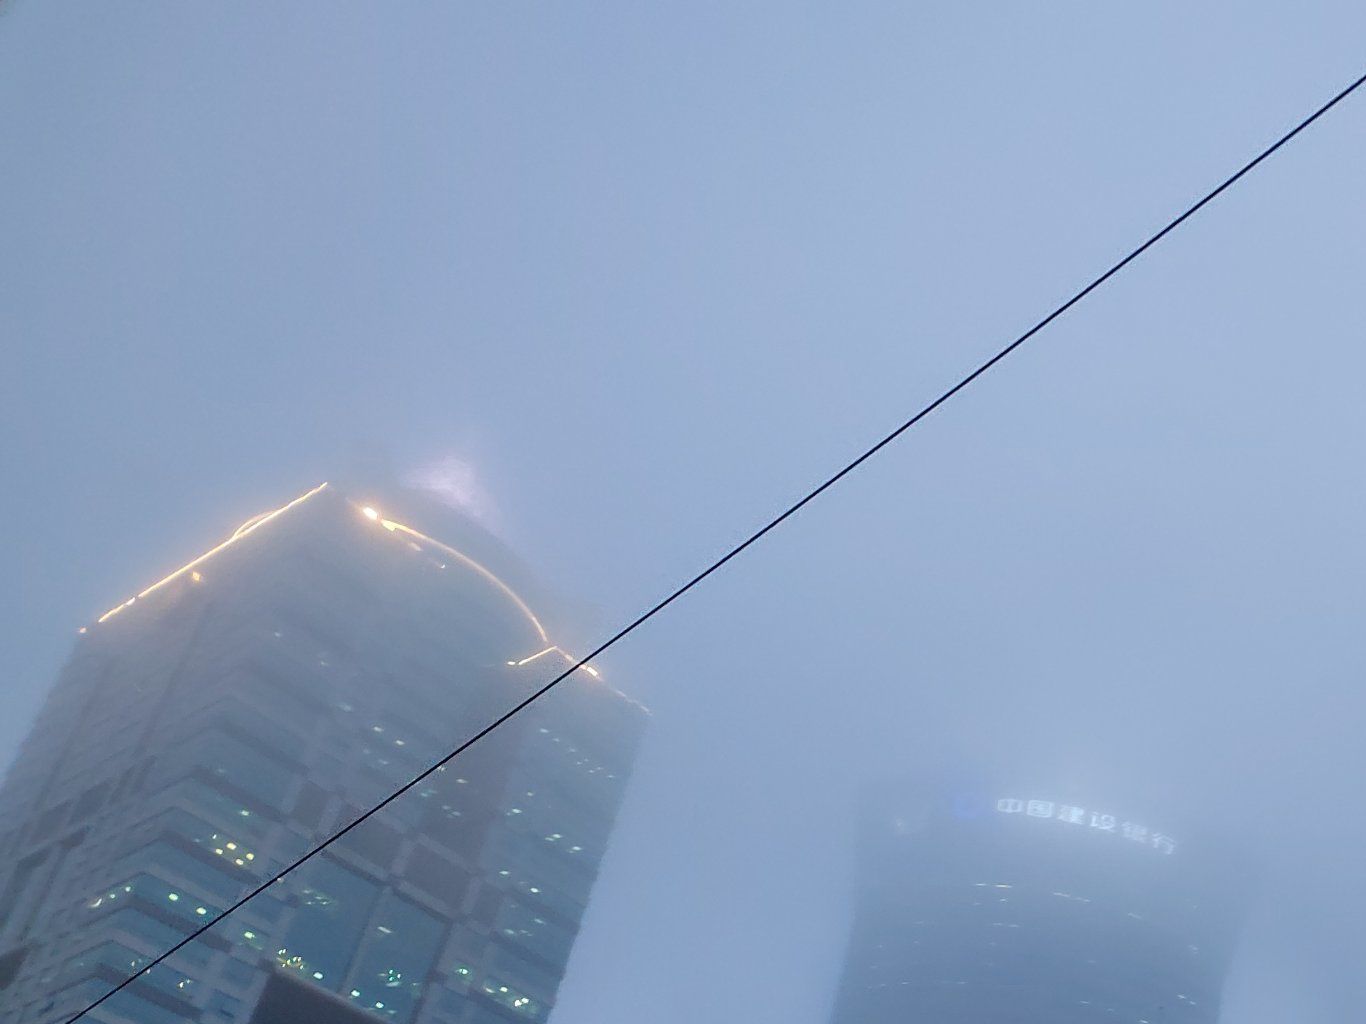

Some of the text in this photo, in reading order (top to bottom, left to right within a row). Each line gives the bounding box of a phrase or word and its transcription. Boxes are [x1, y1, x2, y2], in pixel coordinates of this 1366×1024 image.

[997, 798, 1176, 855] 中国建设银行
